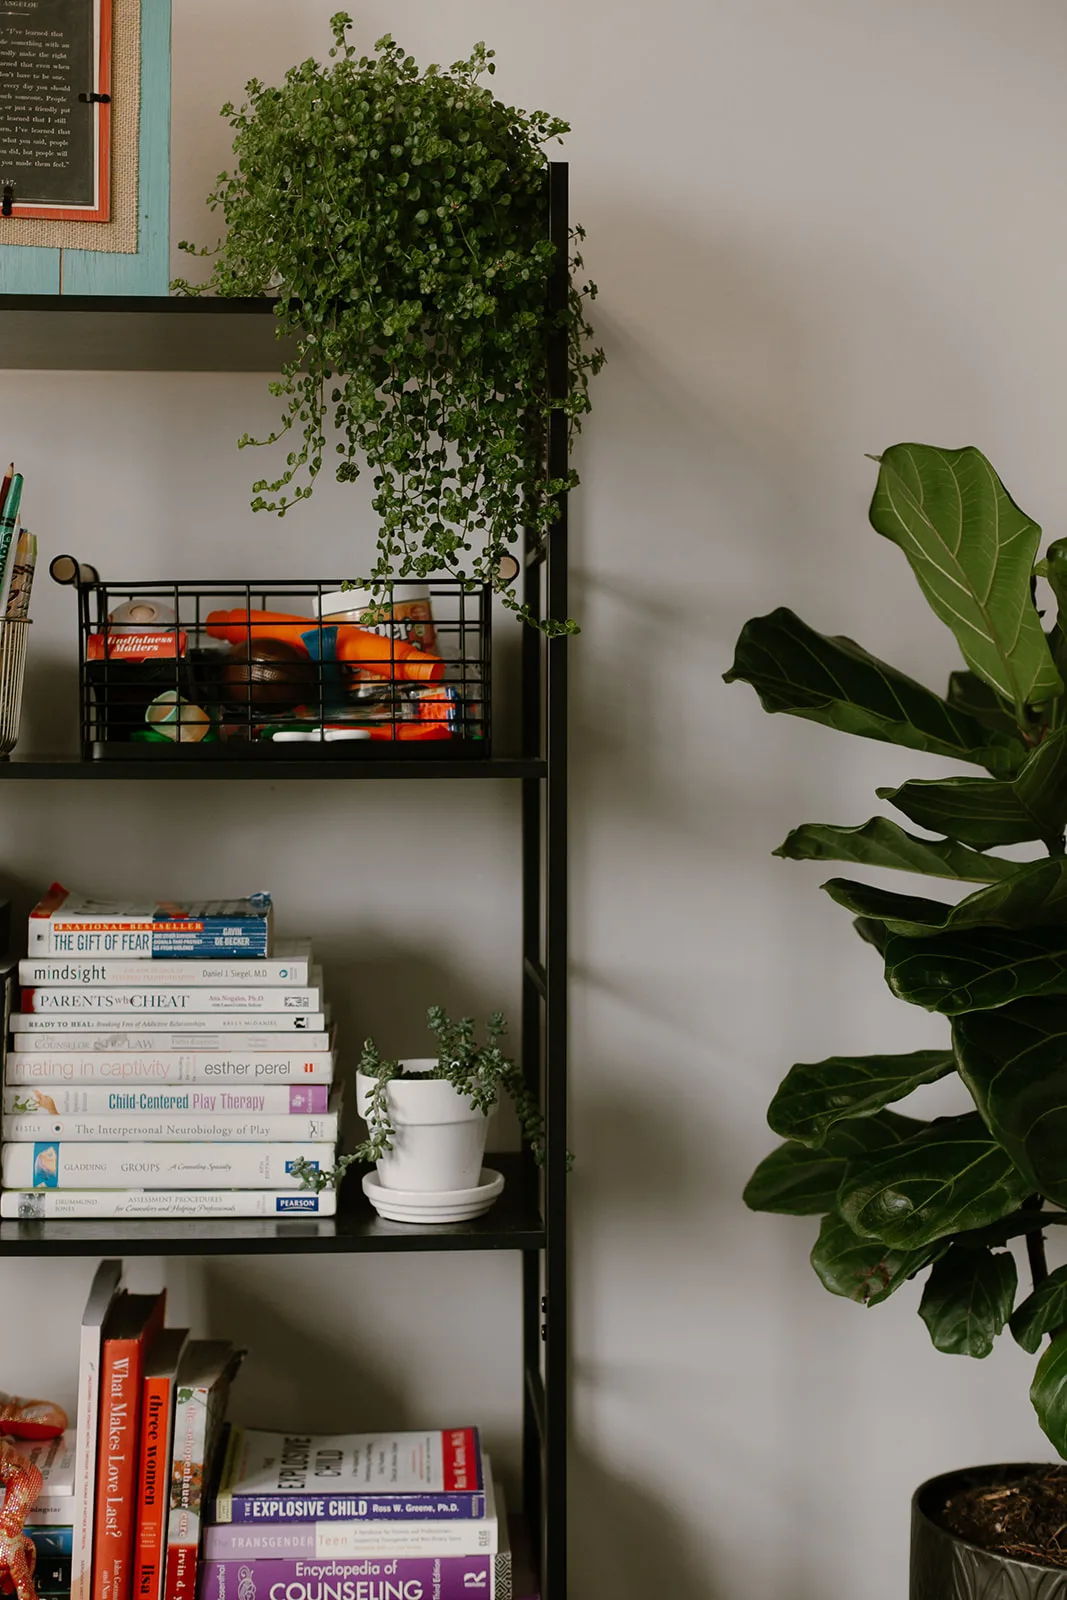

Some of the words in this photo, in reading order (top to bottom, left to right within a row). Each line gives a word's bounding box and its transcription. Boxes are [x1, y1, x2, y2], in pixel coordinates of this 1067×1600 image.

[25, 29, 48, 37] learned
[52, 52, 67, 60] right
[22, 84, 33, 92] day
[46, 95, 67, 103] People
[35, 106, 57, 115] friendly
[49, 140, 69, 148] people
[35, 150, 55, 158] people
[114, 643, 160, 653] Matters
[66, 923, 124, 931] NATIONAL
[129, 922, 203, 931] BESTSELLER
[222, 927, 243, 936] GAVIN
[54, 934, 75, 952] THE
[77, 934, 102, 952] GIFT
[104, 934, 119, 951] OF
[121, 934, 150, 951] FEAR
[214, 937, 224, 946] DE
[224, 937, 250, 946] BECKER
[34, 964, 106, 983] mindsight
[202, 969, 223, 978] Daniel
[40, 995, 114, 1007] PARENTS
[130, 994, 190, 1008] CHEAT
[96, 1021, 121, 1029] Breaking
[15, 1060, 74, 1080] mating
[80, 1060, 94, 1076] in
[100, 1059, 171, 1080] captivity
[204, 1061, 251, 1075] esther
[254, 1061, 291, 1077] perel
[108, 1093, 189, 1110] Child-Centered
[192, 1093, 216, 1112] Play
[220, 1093, 265, 1111] Therapy
[74, 1125, 94, 1134] The
[98, 1125, 163, 1137] Interpersonal
[166, 1125, 233, 1137] Neurobiology
[236, 1125, 247, 1134] of
[250, 1125, 271, 1136] Play
[63, 1163, 107, 1171] GLADDING
[120, 1163, 161, 1172] GROUPS
[279, 1199, 315, 1207] PEARSON
[111, 1356, 130, 1397] What
[147, 1394, 163, 1441] three
[108, 1403, 128, 1451] Makes
[181, 1427, 196, 1509] schopenhauer
[277, 1437, 312, 1489] EXPLOSIVE
[314, 1449, 344, 1477] CHILD
[107, 1455, 125, 1493] Love
[145, 1445, 158, 1505] women
[253, 1501, 325, 1517] EXPLOSIVE
[328, 1500, 368, 1516] CHILD
[372, 1503, 391, 1513] Ross
[392, 1503, 404, 1512] W.
[405, 1503, 436, 1514] Greene,
[437, 1503, 460, 1513] Ph.D.
[105, 1497, 124, 1538] Last?
[178, 1511, 190, 1537] cure
[231, 1536, 314, 1548] TRANSGENDER
[318, 1536, 348, 1546] Teen
[176, 1548, 188, 1577] irvin
[295, 1560, 381, 1581] Encyclopedia
[383, 1559, 398, 1576] of
[432, 1558, 441, 1583] Edition
[140, 1565, 155, 1594] lisa
[269, 1579, 424, 1600] COUNSELING
[432, 1583, 441, 1600] Third
